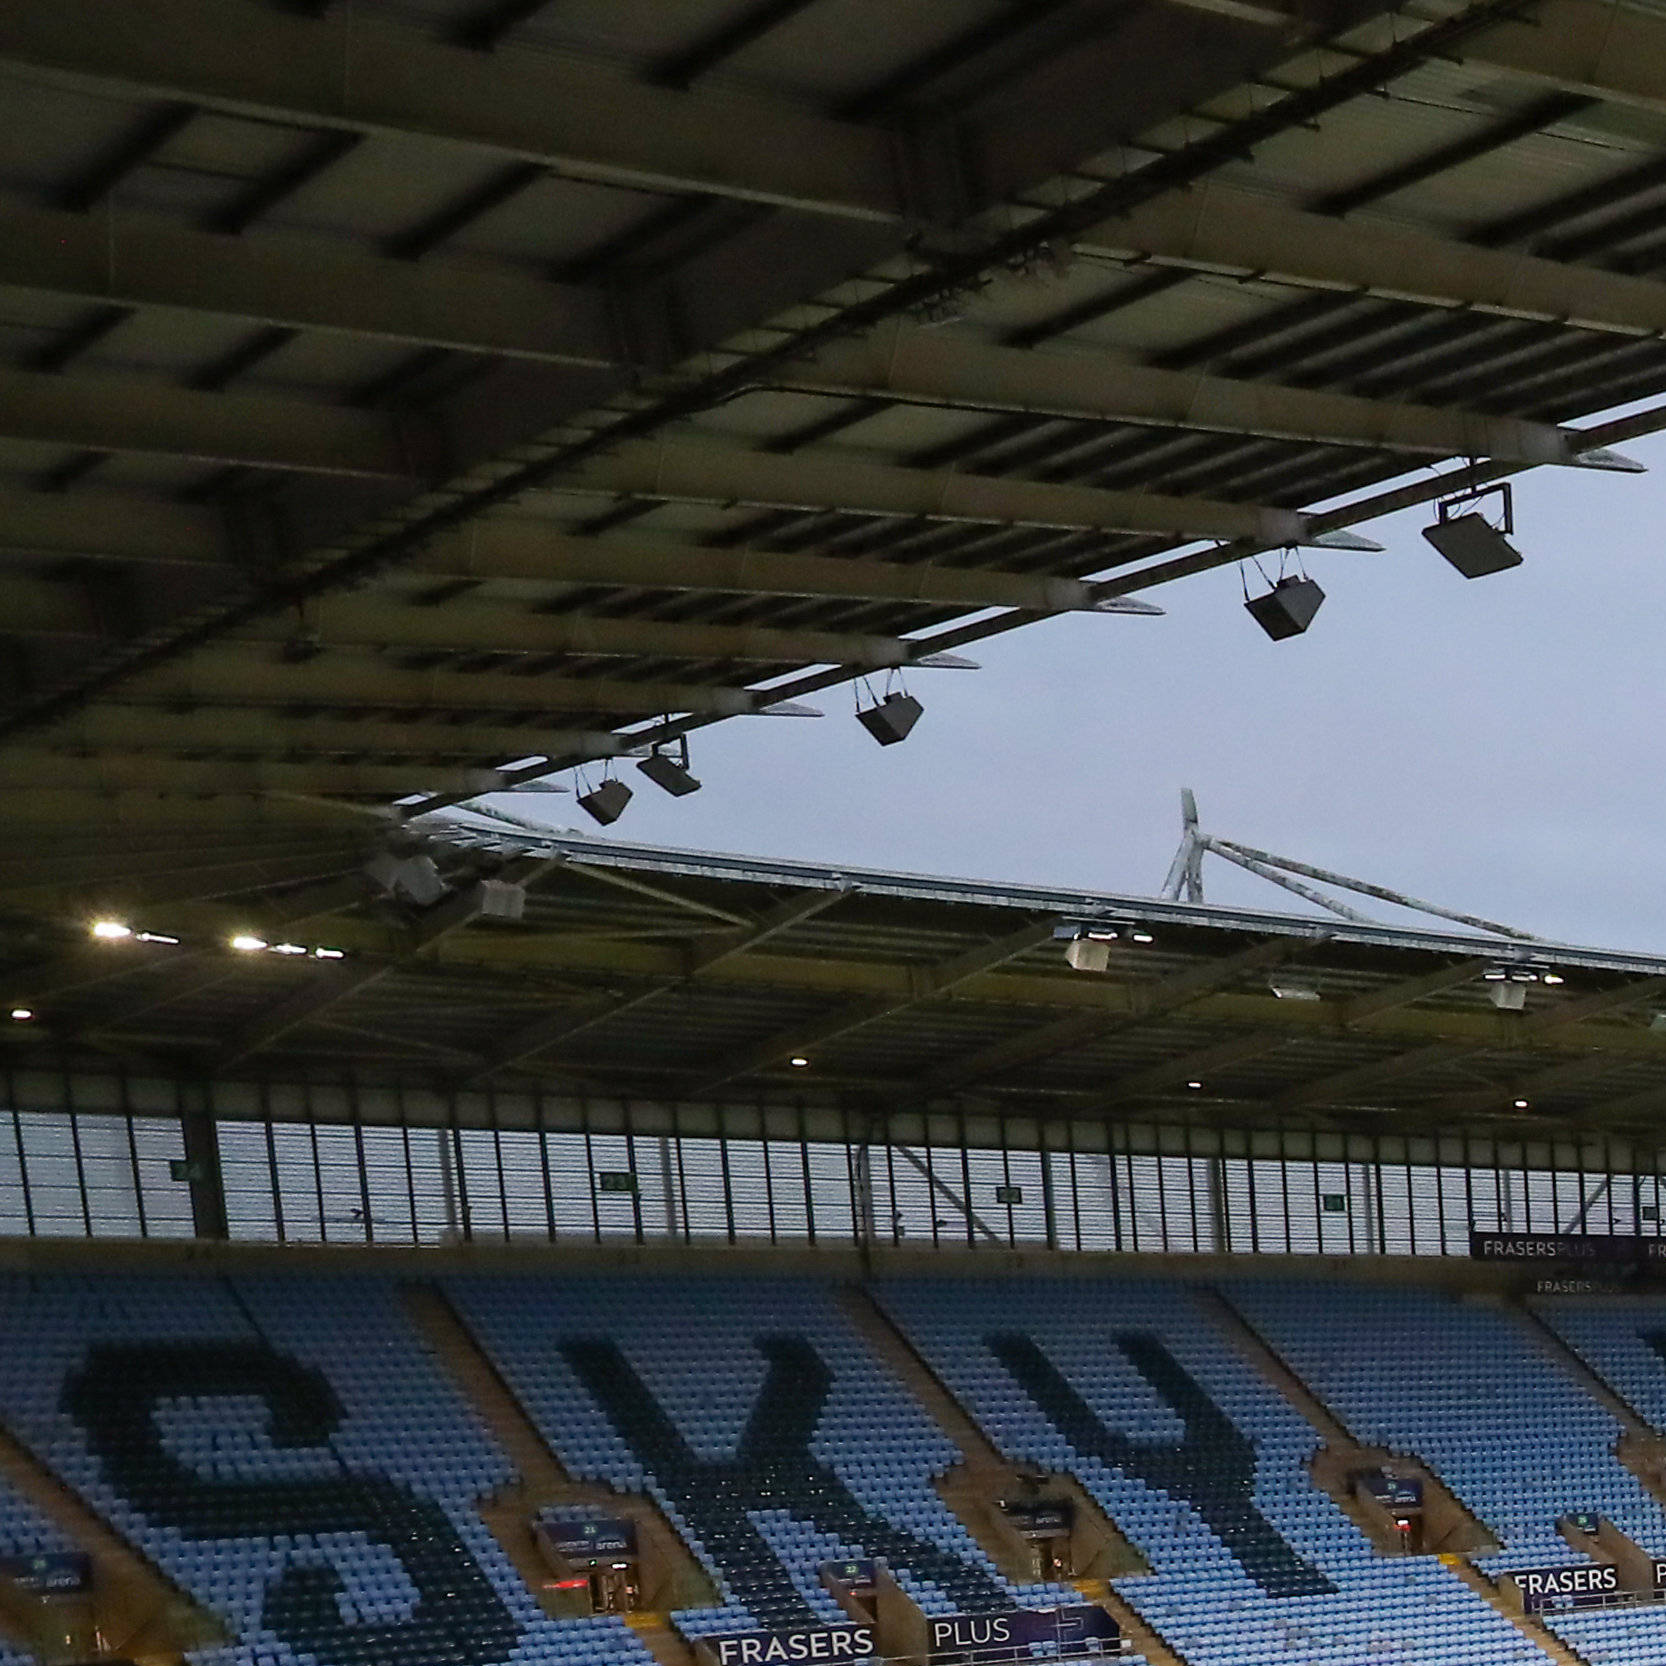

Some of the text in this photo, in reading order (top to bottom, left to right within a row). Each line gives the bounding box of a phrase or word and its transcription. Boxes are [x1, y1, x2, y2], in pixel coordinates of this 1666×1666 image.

[1514, 1567, 1617, 1596] FRASERS
[720, 1618, 1010, 1666] FRASERS PLUS
